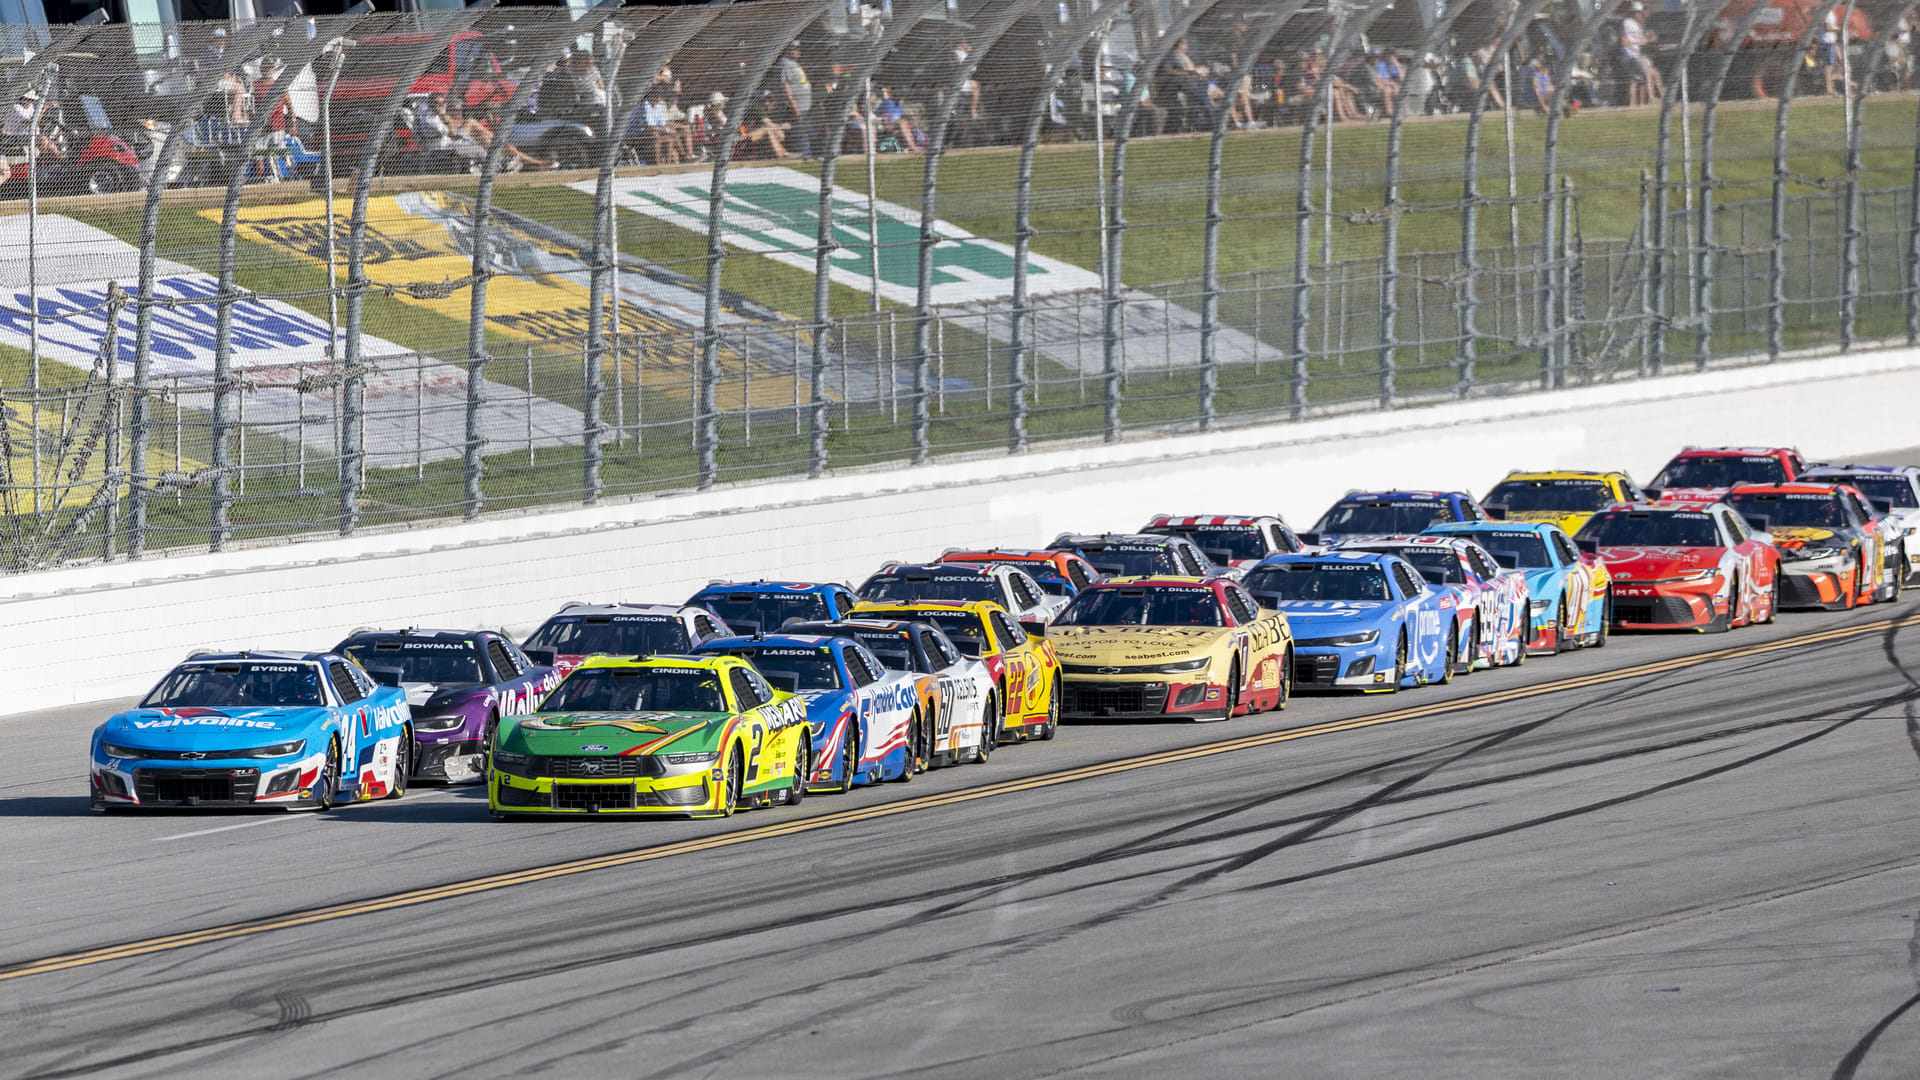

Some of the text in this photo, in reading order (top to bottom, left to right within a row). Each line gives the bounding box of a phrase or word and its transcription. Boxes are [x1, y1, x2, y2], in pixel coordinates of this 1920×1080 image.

[1058, 639, 1118, 647] SEAFOOD
[1143, 640, 1178, 648] LOVE
[1124, 650, 1190, 660] seabest.com
[1006, 661, 1025, 715] 22
[134, 717, 276, 730] Valvoline
[745, 722, 763, 784] 2
[106, 759, 121, 771] 24
[503, 774, 511, 785] 2
